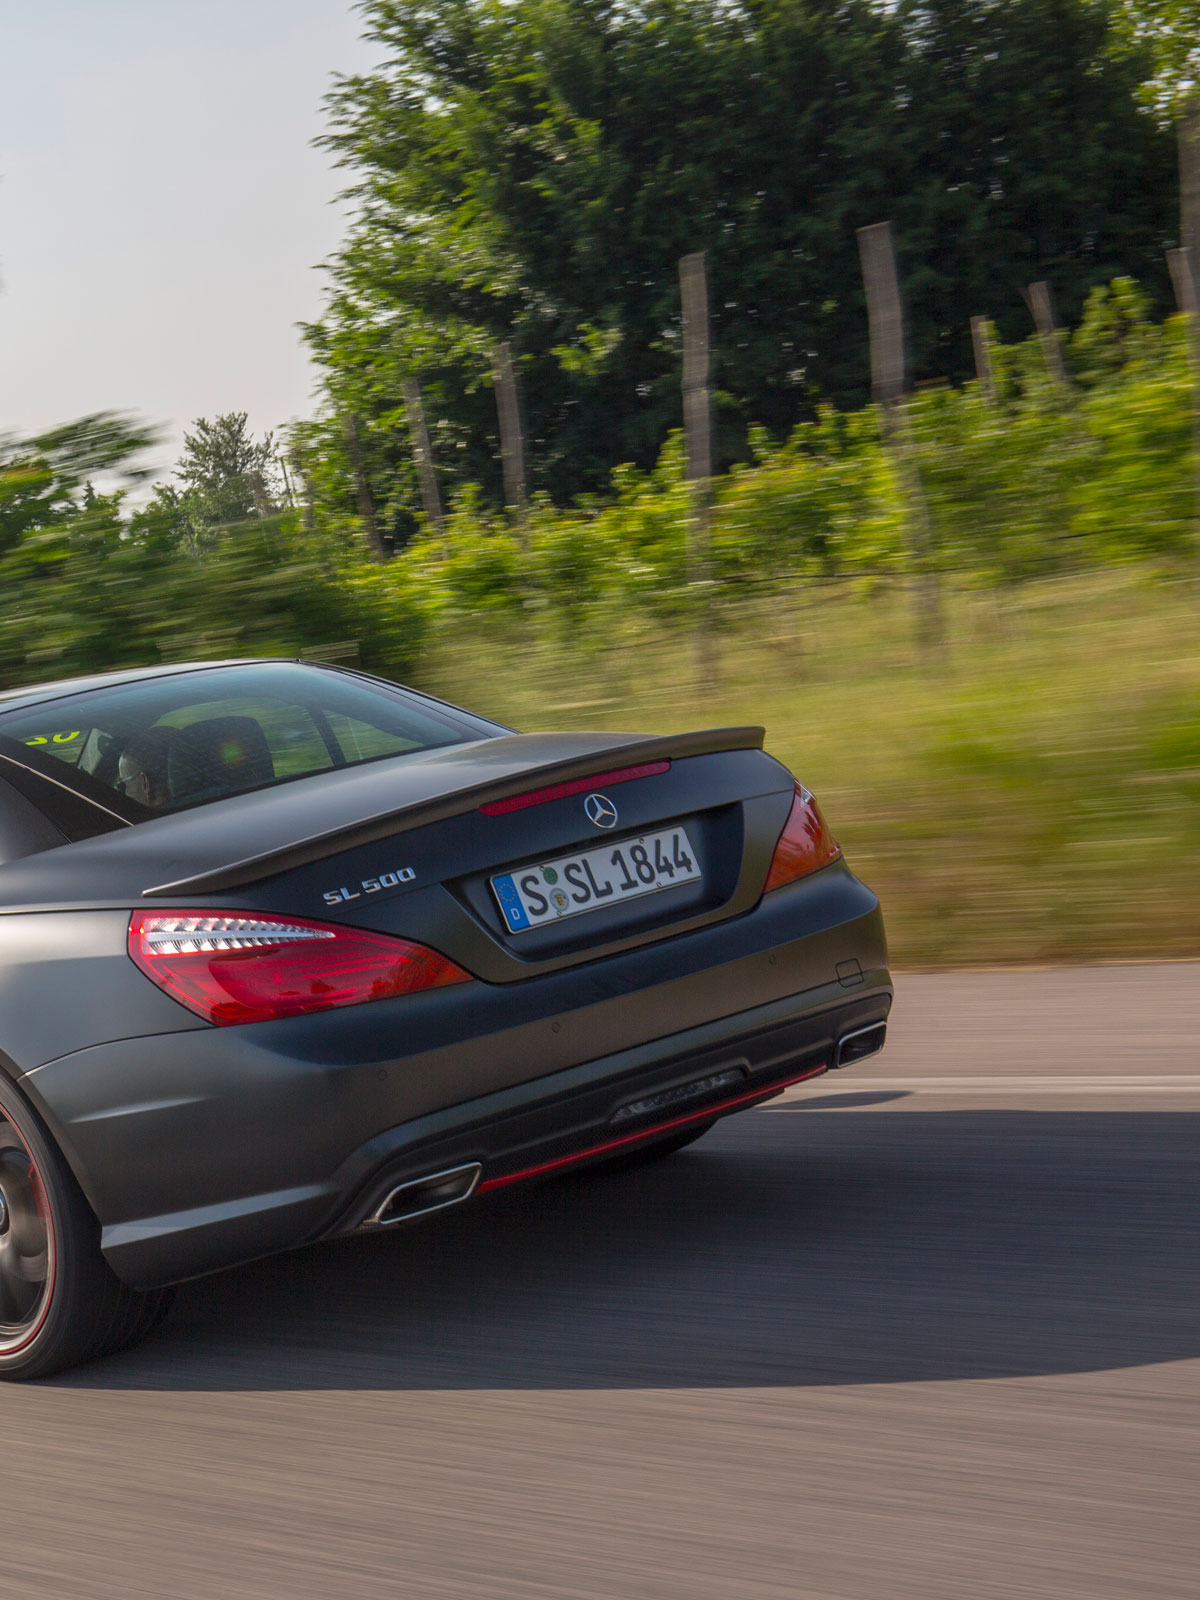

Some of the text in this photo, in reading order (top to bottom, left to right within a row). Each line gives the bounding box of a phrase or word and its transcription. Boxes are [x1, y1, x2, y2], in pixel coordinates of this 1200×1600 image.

[323, 867, 416, 905] SL 500
[520, 834, 693, 916] S SL 1844
[510, 908, 520, 920] D
